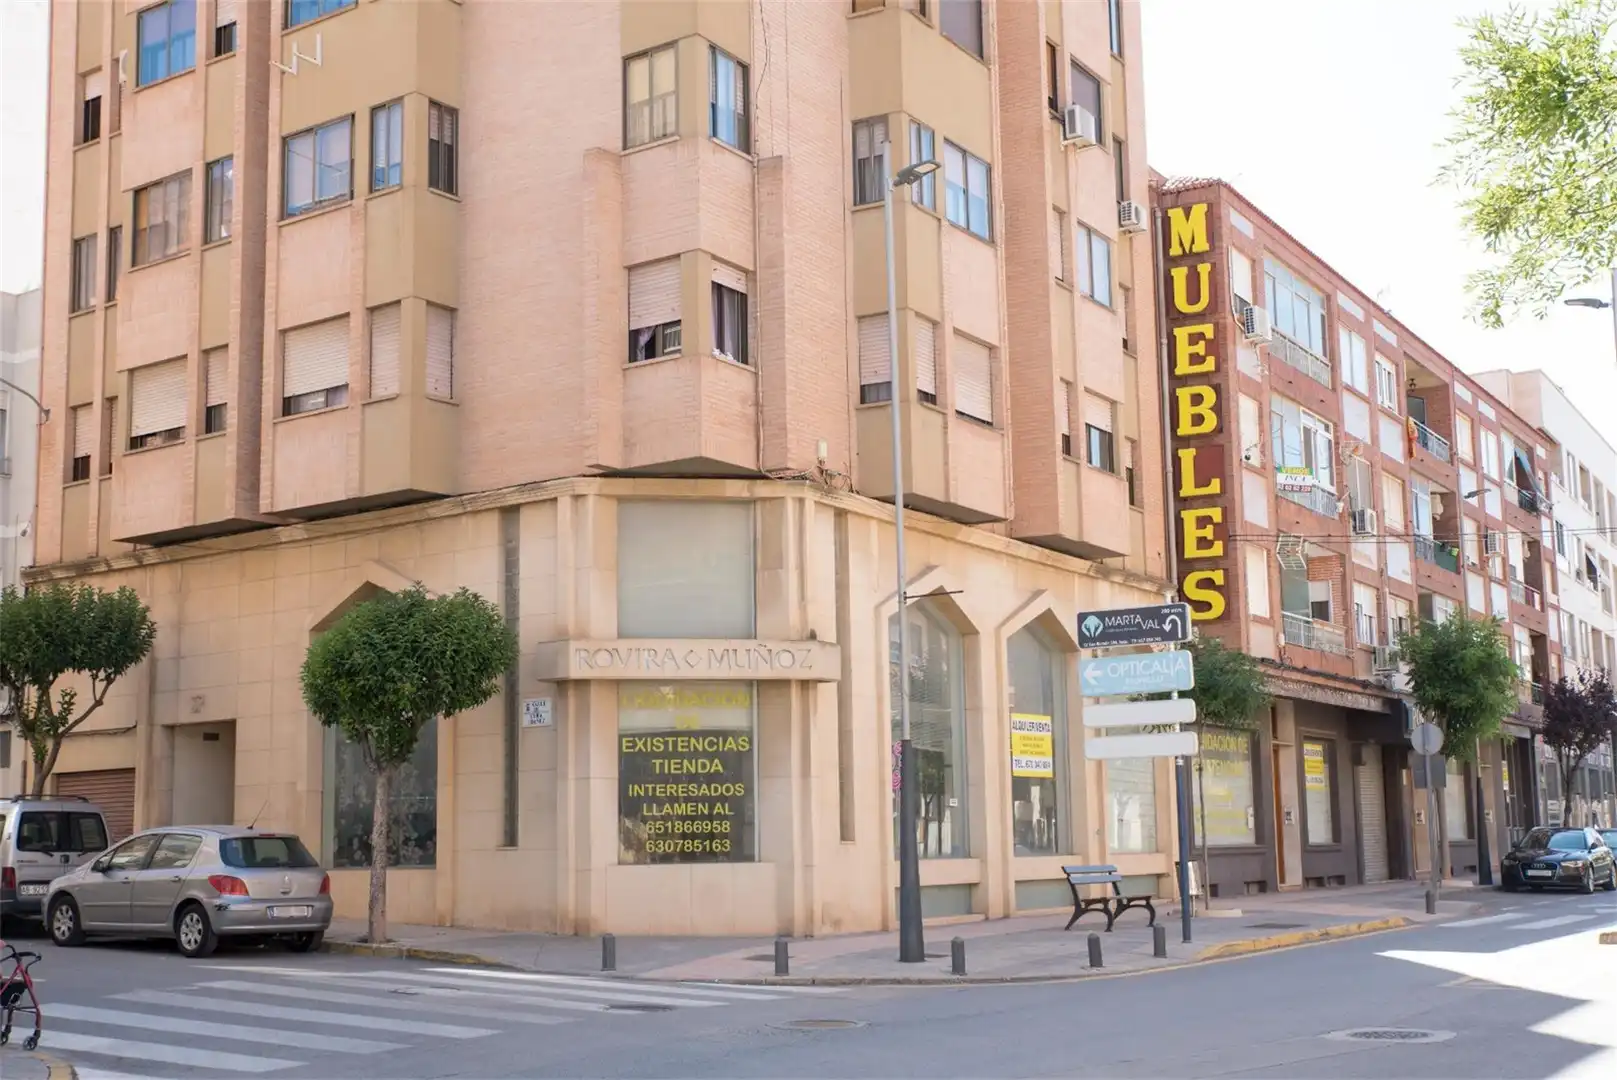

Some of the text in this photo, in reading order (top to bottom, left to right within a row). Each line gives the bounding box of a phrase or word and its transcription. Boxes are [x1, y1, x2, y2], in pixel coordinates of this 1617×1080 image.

[1167, 203, 1226, 621] MUEBLES
[1104, 614, 1141, 627] MARTA
[1140, 619, 1161, 630] VAL
[575, 643, 813, 671] ROVIRA MUÑOZ
[622, 736, 749, 752] EXISTENCIAS
[652, 758, 724, 774] TIENDA
[629, 784, 745, 798] INTERESADOS
[643, 803, 735, 816] LLAMEN AL
[646, 821, 731, 834] 651866958
[646, 839, 731, 853] 630785163
